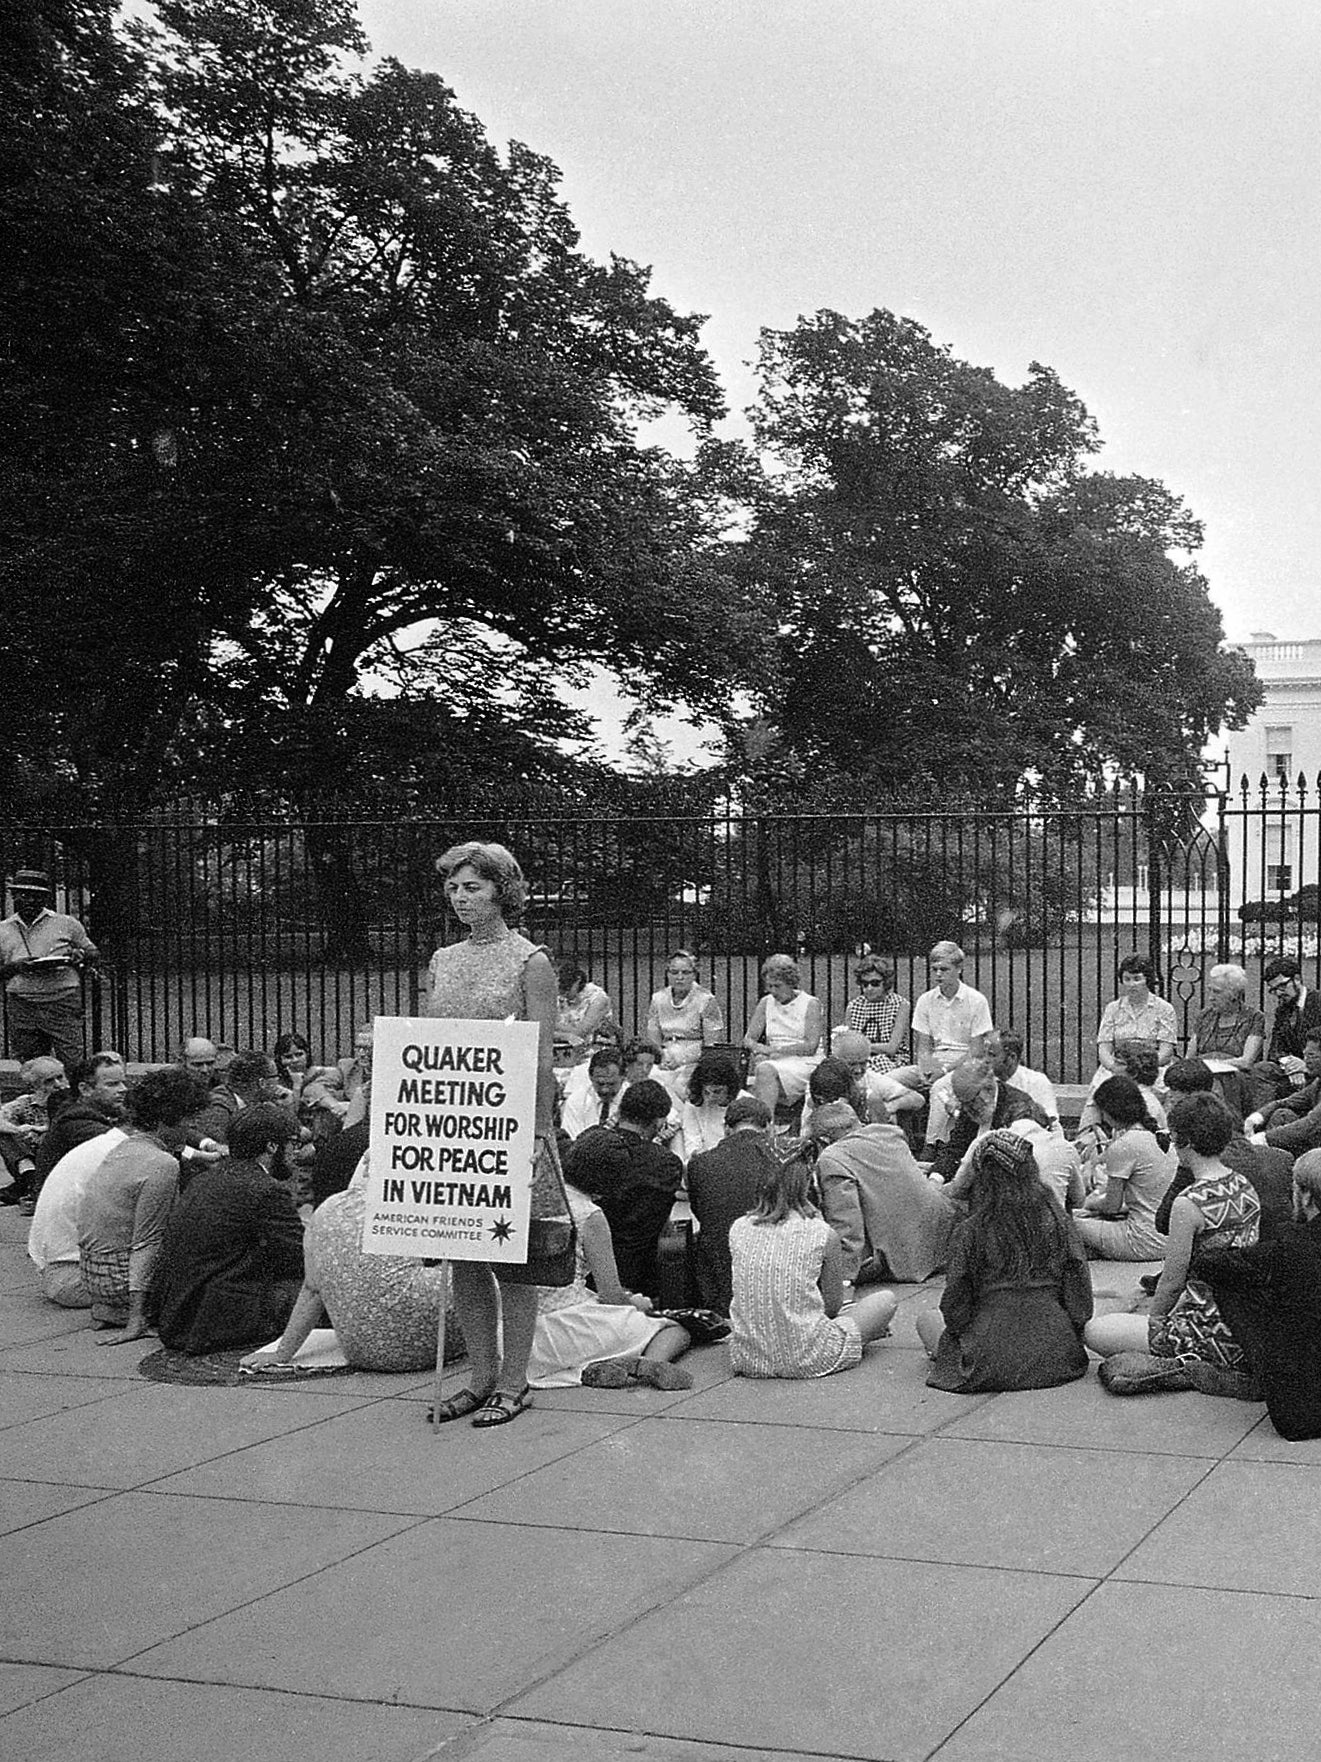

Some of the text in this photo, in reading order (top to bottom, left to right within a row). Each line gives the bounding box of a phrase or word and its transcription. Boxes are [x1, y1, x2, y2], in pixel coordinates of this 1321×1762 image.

[401, 1044, 505, 1076] QUAKER
[397, 1078, 507, 1108] MEETING
[384, 1112, 520, 1142] FOR WORSHIP
[391, 1145, 509, 1176] FOR PEACE
[382, 1178, 512, 1209] IN VIETNAM
[371, 1224, 483, 1241] SERVICE COMMITTEE
[373, 1212, 484, 1228] AMERICAN FRIENDS
